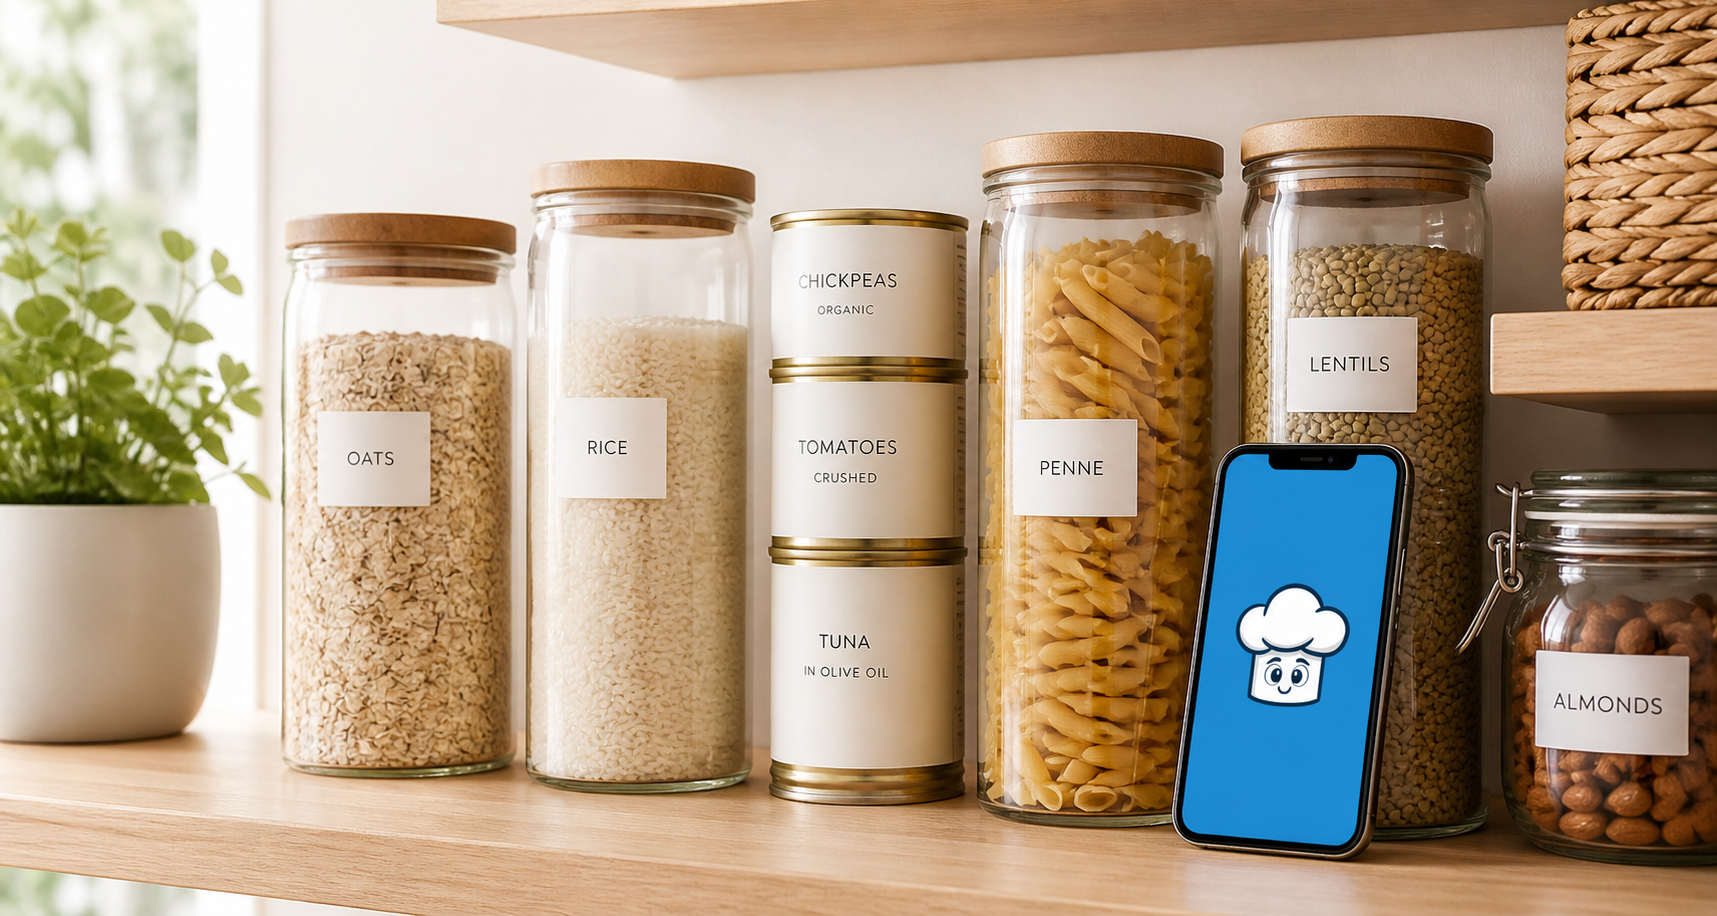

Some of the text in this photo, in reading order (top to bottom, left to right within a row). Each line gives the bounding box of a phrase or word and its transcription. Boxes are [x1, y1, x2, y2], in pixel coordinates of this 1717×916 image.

[798, 272, 898, 289] CHICKPEAS
[817, 304, 875, 316] ORGANIC
[1310, 355, 1390, 373] LENTILS
[587, 439, 628, 456] RICE
[798, 439, 898, 455] TOMATOES
[347, 450, 395, 467] OATS
[1040, 460, 1104, 476] PENNE
[813, 472, 878, 484] CRUSHED
[818, 633, 871, 650] TUNA
[804, 665, 889, 679] IN OLIVE OIL
[1553, 692, 1663, 715] ALMONDS
